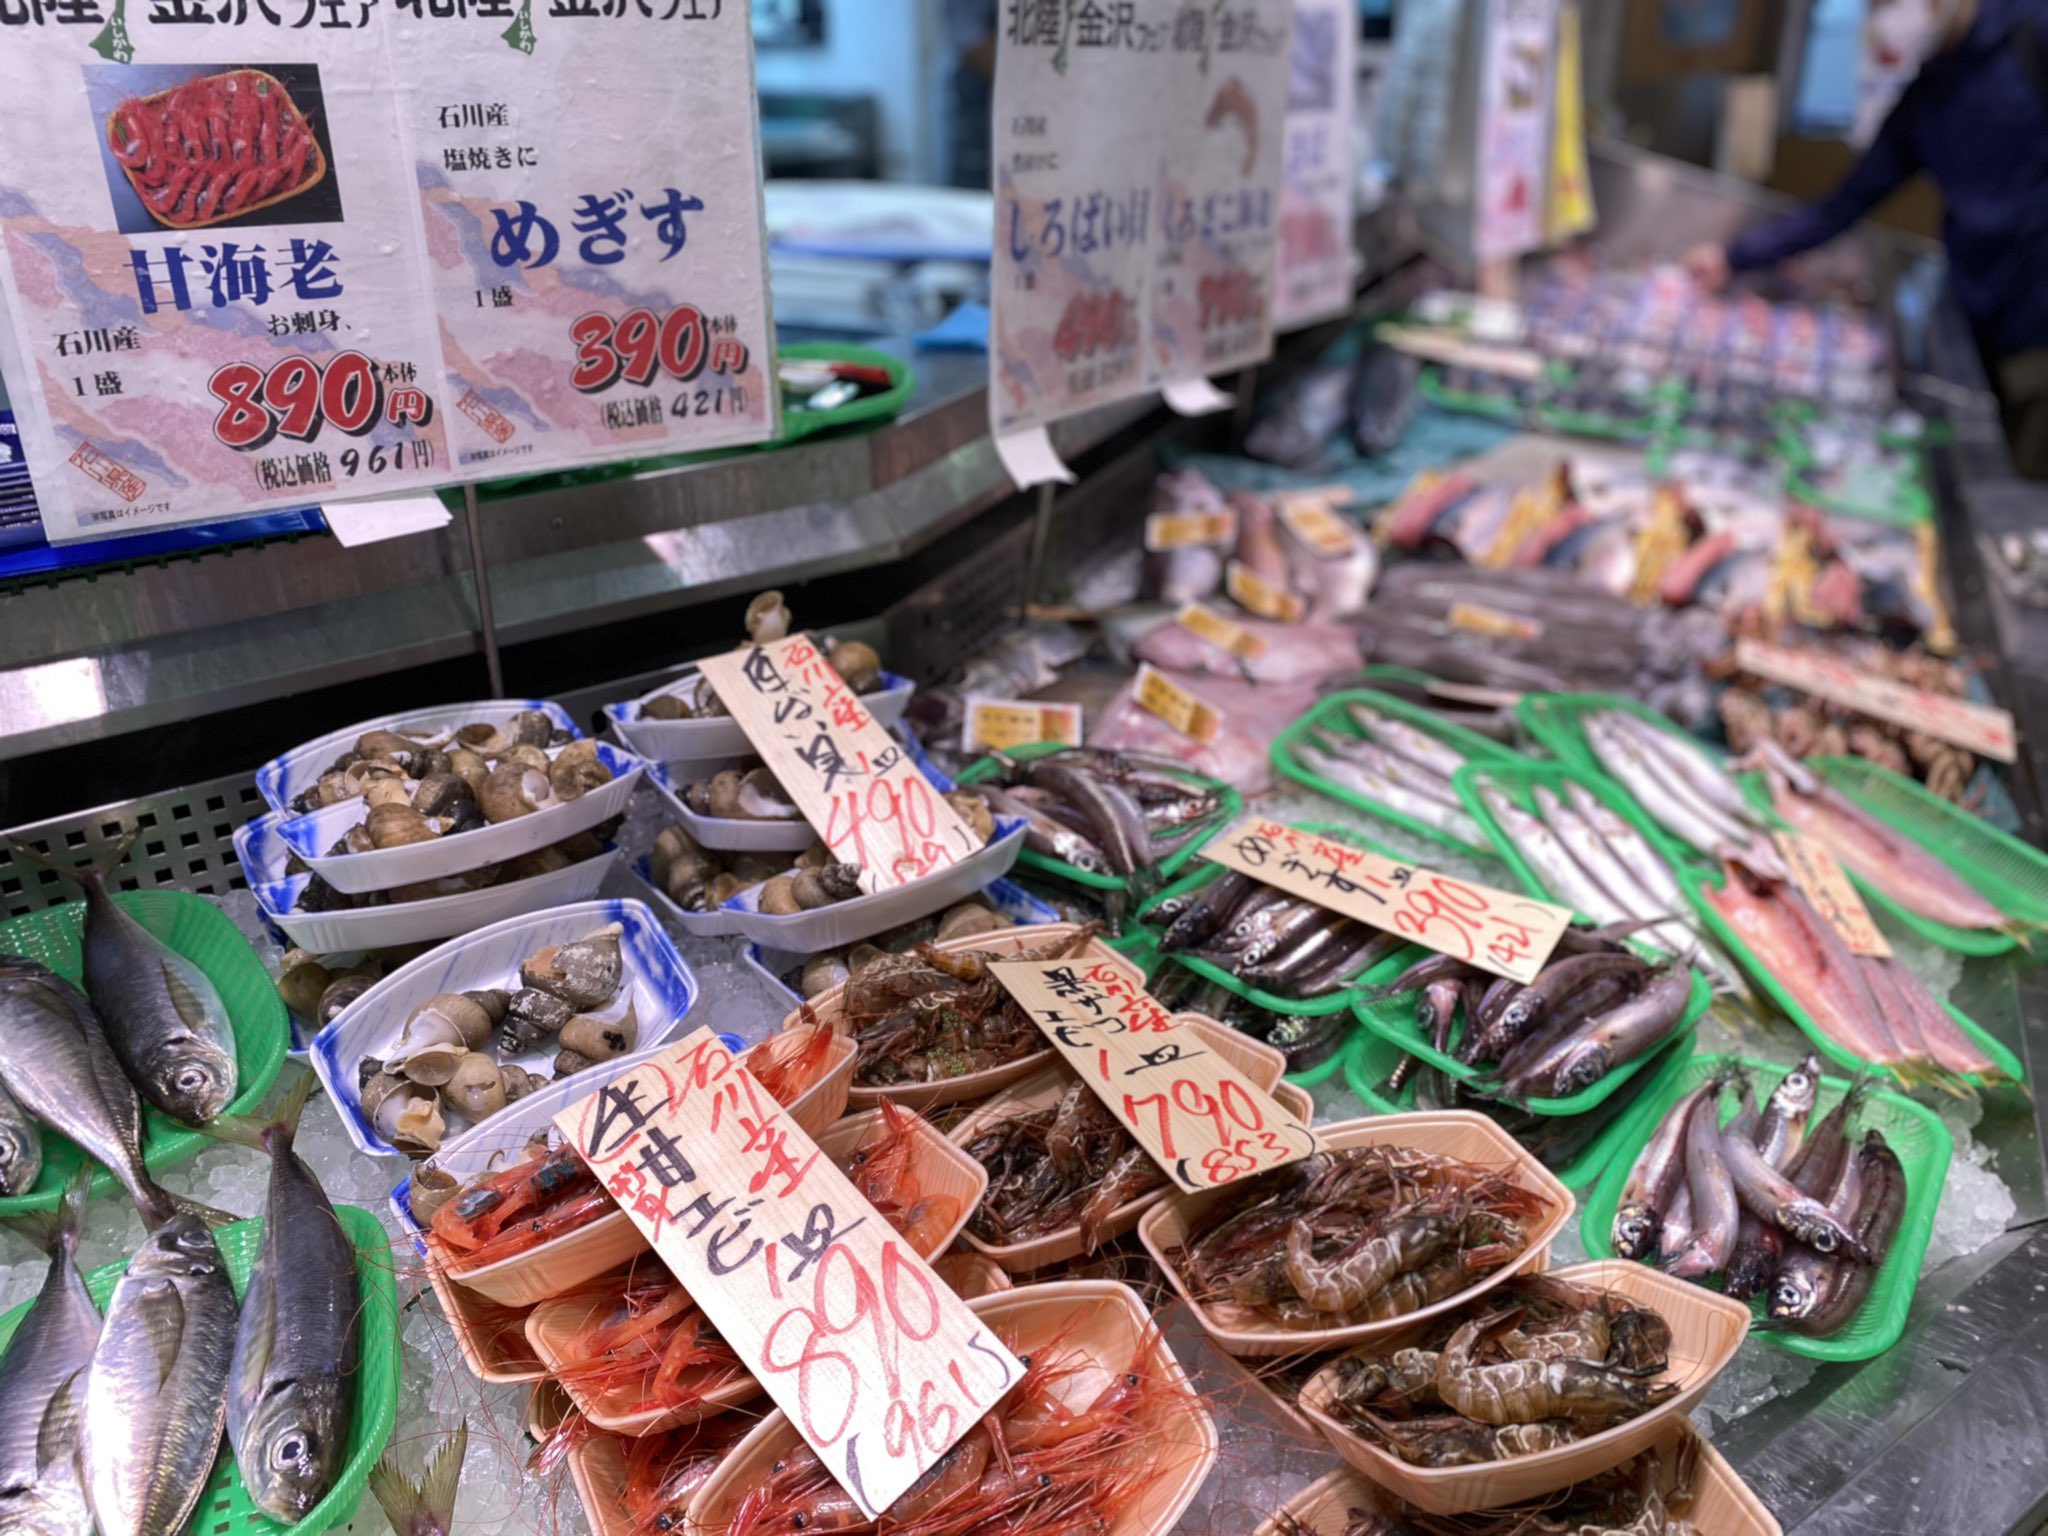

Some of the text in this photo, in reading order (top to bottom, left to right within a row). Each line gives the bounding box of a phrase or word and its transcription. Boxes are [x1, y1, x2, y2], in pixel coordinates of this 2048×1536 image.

[437, 103, 509, 129] 石川産
[443, 146, 539, 172] 塩焼きに
[490, 188, 705, 269] めぎす
[122, 238, 344, 315] 甘海老
[52, 325, 142, 357] 石川産
[824, 775, 936, 870] 490
[1394, 876, 1490, 962] 390
[1123, 1079, 1264, 1160] 790
[761, 1240, 940, 1449] 890
